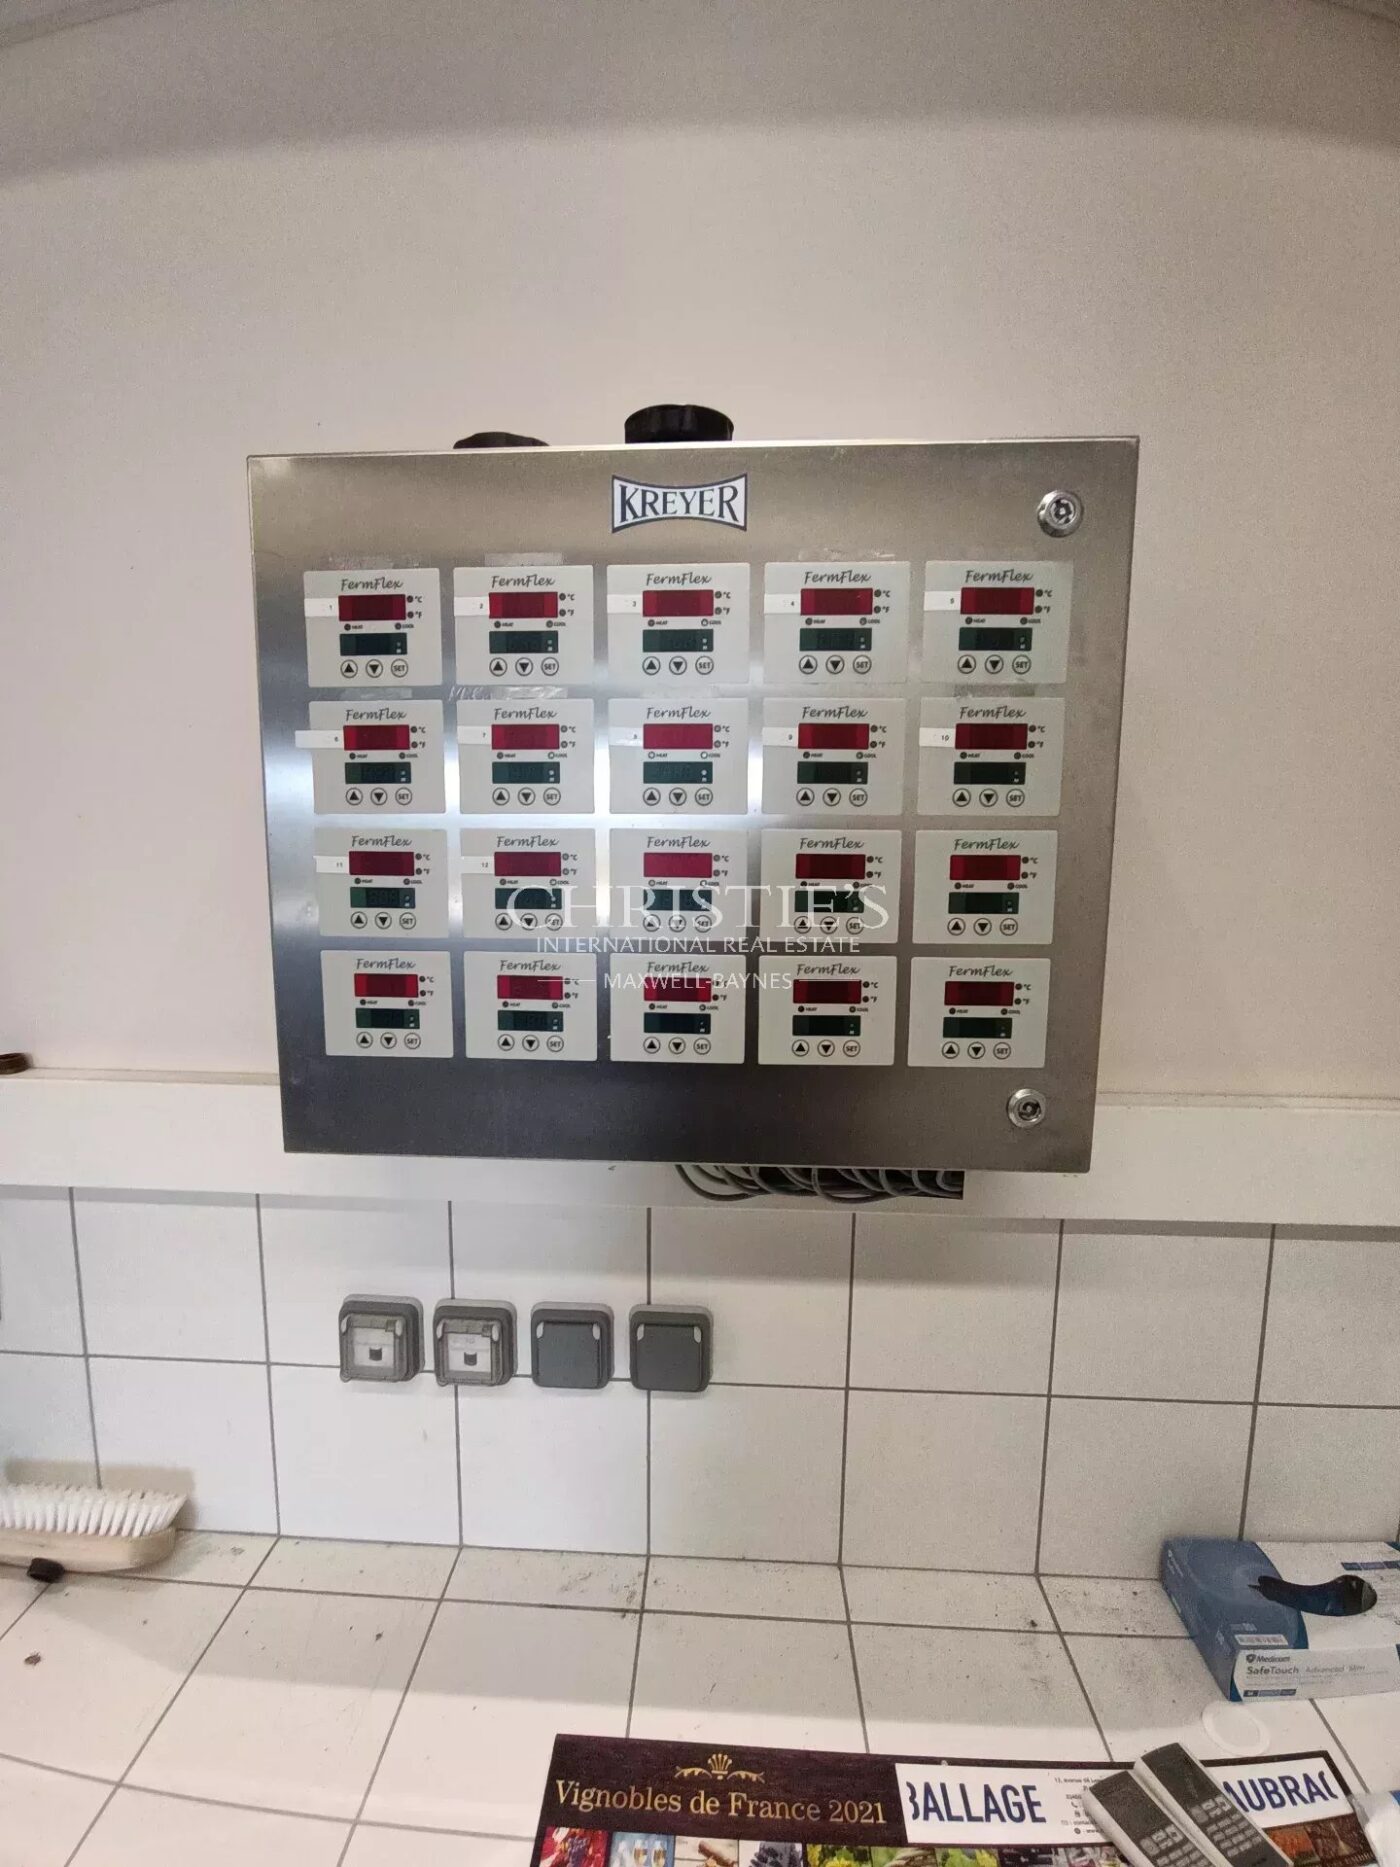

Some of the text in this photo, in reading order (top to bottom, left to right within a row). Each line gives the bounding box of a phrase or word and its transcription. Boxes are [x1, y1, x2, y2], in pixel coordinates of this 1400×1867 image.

[619, 484, 739, 523] KREYER
[491, 574, 555, 588] FermFlex
[646, 572, 712, 586] FermFlex
[804, 570, 871, 584] FermFlex
[965, 569, 1033, 583] FermFlex
[341, 577, 403, 590] FermFlex
[394, 664, 405, 672] SET
[699, 662, 711, 670] SET
[856, 661, 869, 669] SET
[1015, 661, 1028, 669] SET
[346, 708, 407, 721] FermFlex
[494, 707, 557, 720] FermFlex
[646, 706, 711, 720] FermFlex
[802, 706, 868, 719] FermFlex
[959, 705, 1027, 719] FermFlex
[698, 793, 710, 801] SET
[1010, 794, 1022, 802] SET
[351, 835, 412, 848] FermFlex
[496, 836, 559, 848] FermFlex
[647, 836, 710, 848] FermFlex
[800, 837, 865, 850] FermFlex
[954, 838, 1020, 851] FermFlex
[356, 958, 416, 970] FermFlex
[499, 960, 561, 972] FermFlex
[797, 964, 861, 976] FermFlex
[949, 965, 1013, 978] FermFlex
[1247, 1665, 1299, 1675] SafeTouch
[555, 1780, 887, 1824] Vignobles de France 2021
